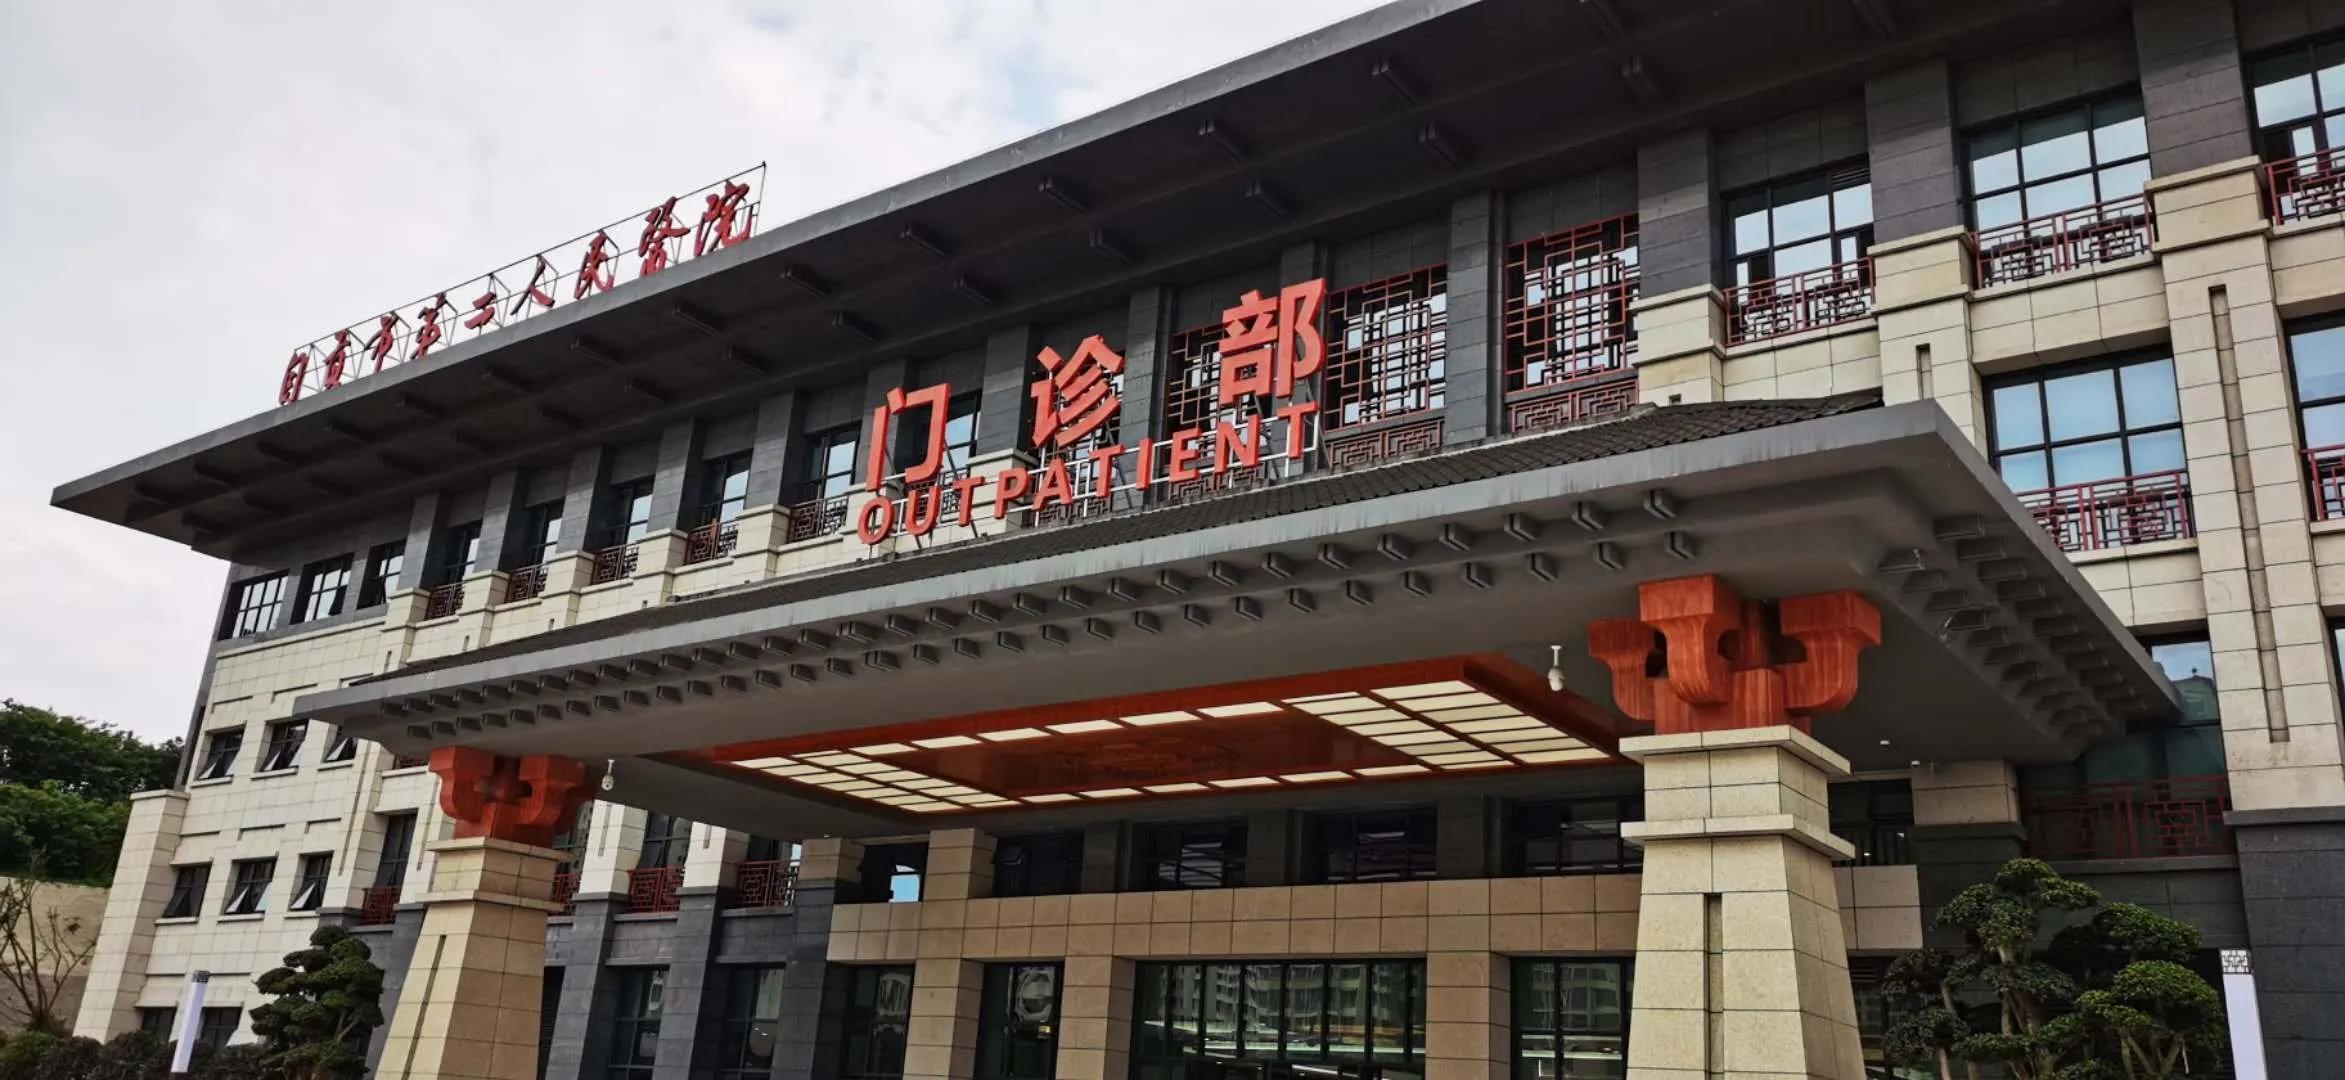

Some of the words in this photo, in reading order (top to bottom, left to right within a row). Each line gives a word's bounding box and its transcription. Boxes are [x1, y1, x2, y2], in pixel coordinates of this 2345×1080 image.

[857, 401, 1320, 544] OUTPATIENT
[866, 278, 1327, 492] 门诊部
